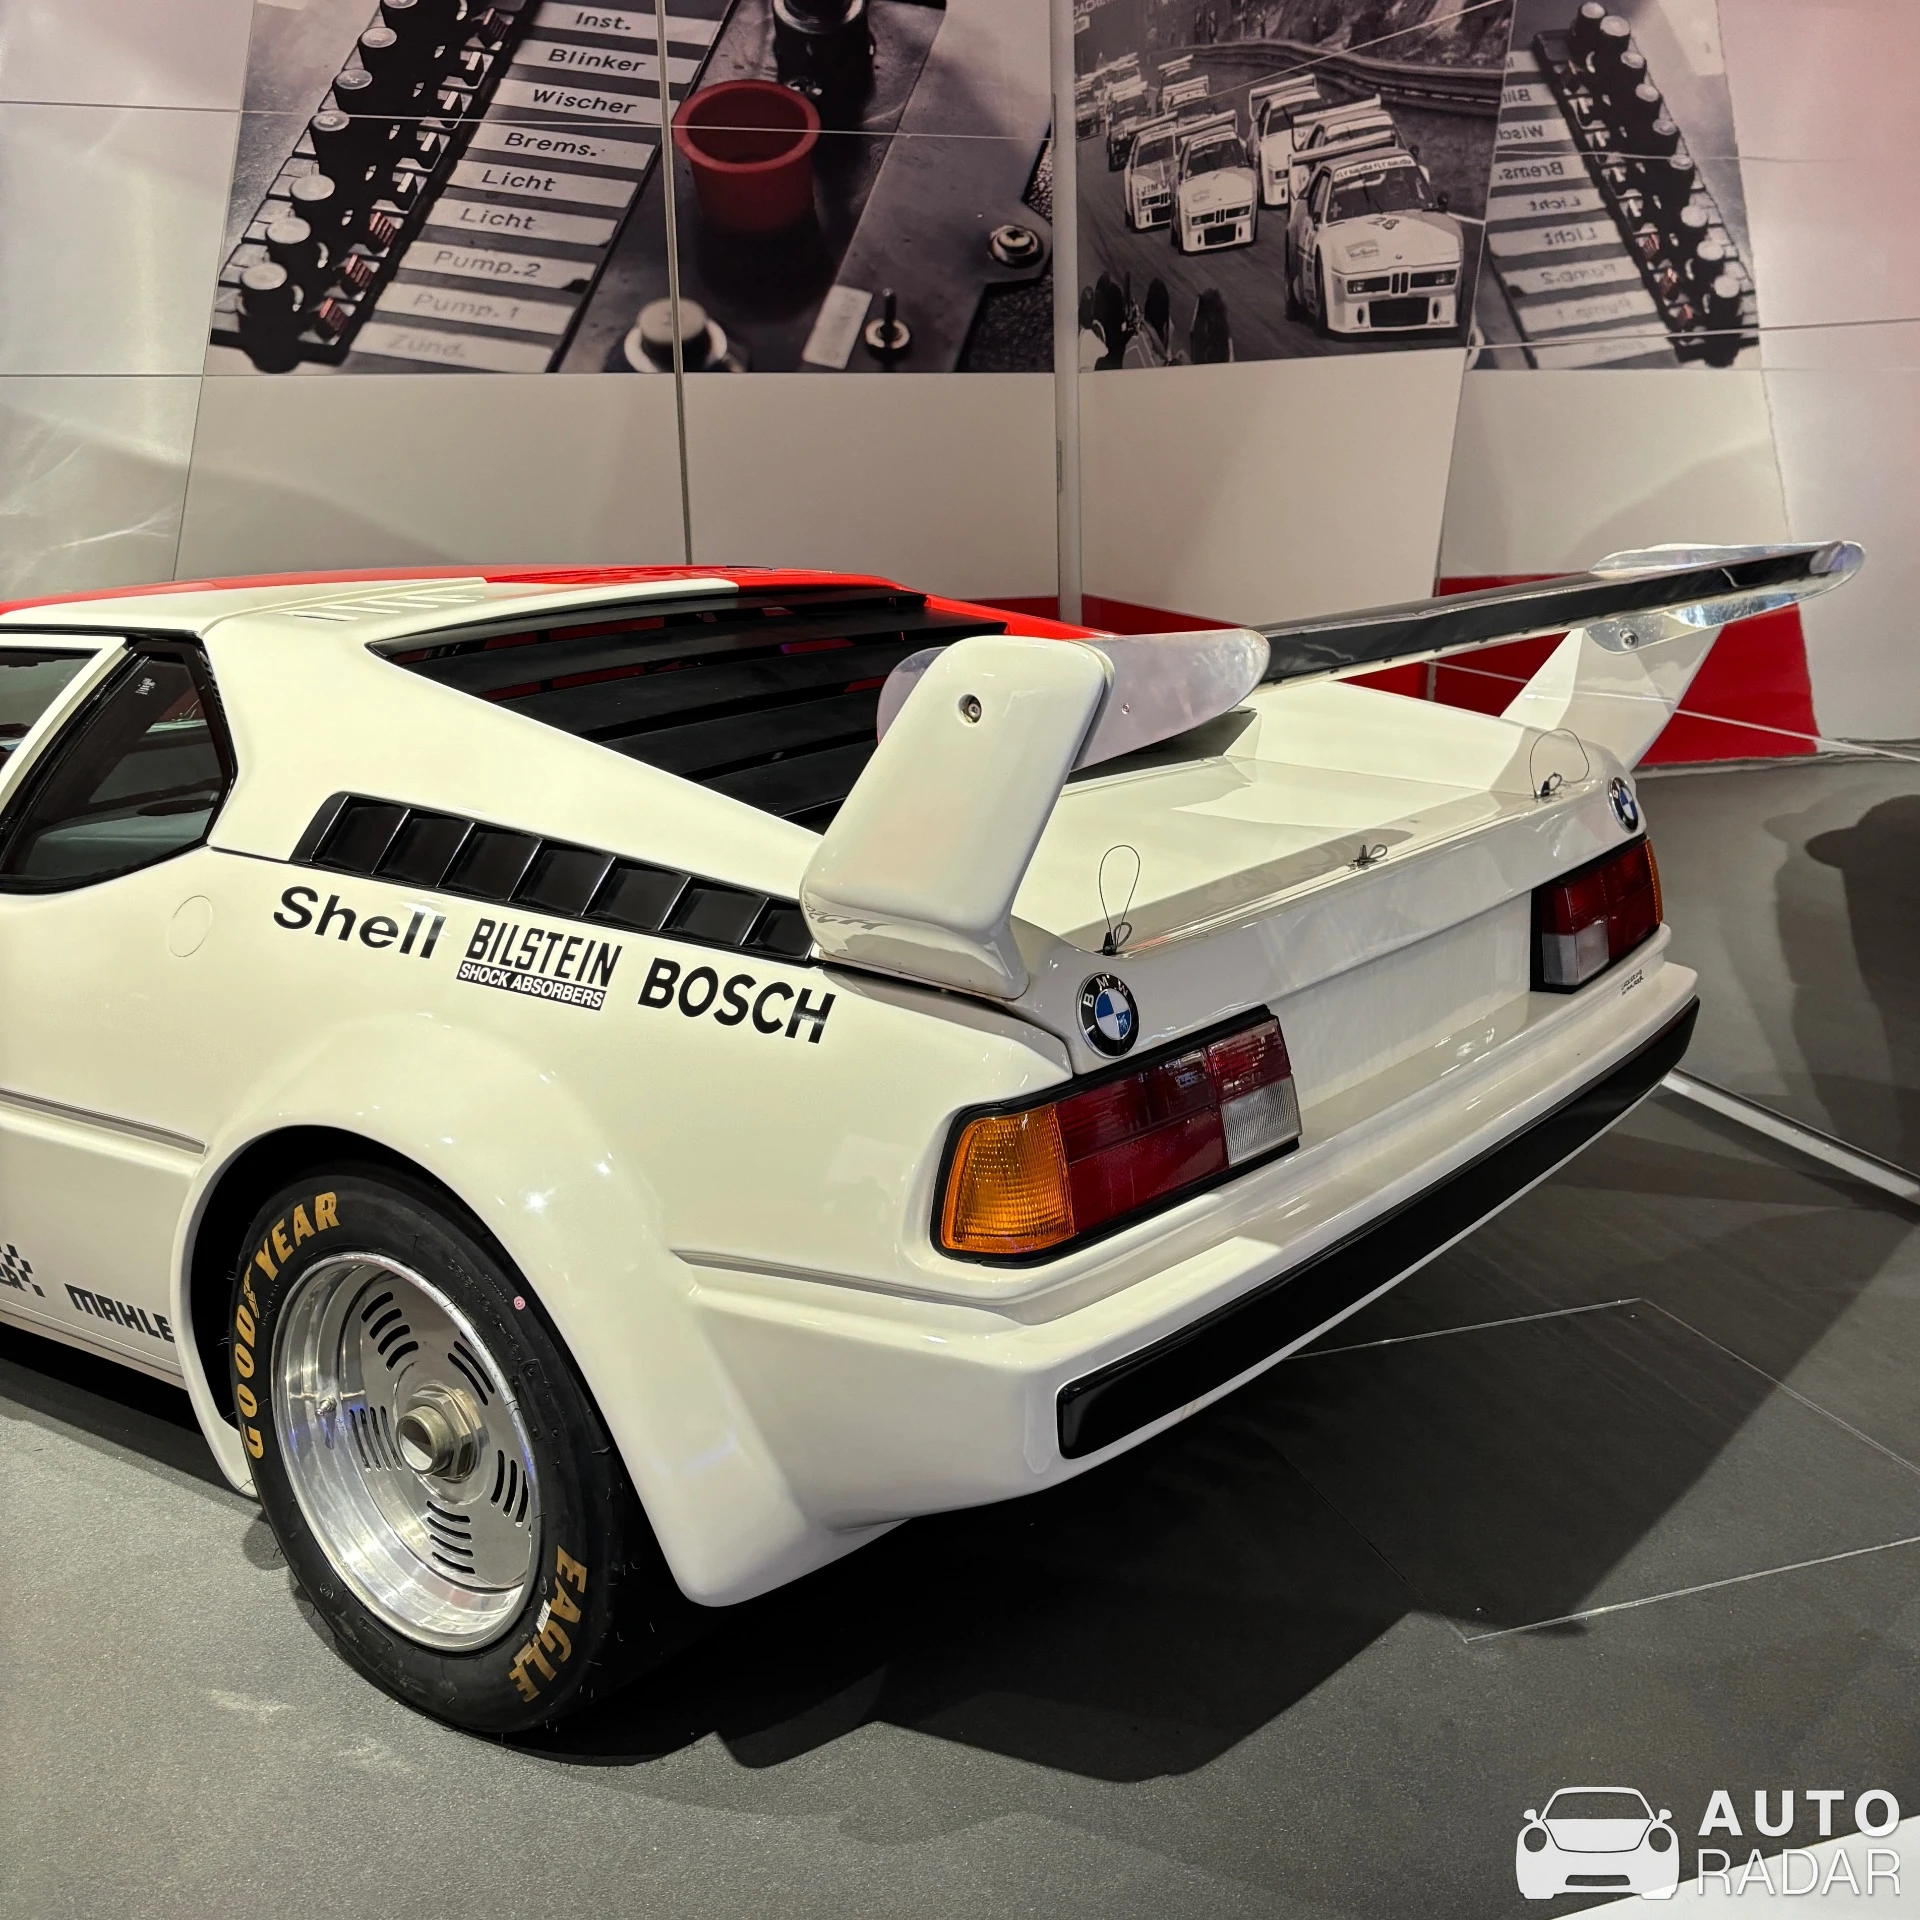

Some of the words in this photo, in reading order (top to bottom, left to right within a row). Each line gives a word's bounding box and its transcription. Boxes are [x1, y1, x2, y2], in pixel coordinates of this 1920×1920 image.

[575, 12, 631, 31] Inst.
[548, 48, 646, 73] Blinker
[532, 89, 637, 116] Wischer
[504, 132, 597, 157] Brems.
[482, 169, 556, 193] Licht
[460, 207, 537, 230] Licht
[434, 250, 541, 277] Pump.2
[273, 886, 447, 960] Shell
[465, 918, 623, 988] BILSTEIN
[459, 963, 512, 988] SHOCK
[510, 975, 604, 1008] ABSORBERS
[637, 957, 837, 1044] BOSCH
[64, 1283, 175, 1343] MAHLE
[508, 1544, 588, 1703] EAGLE
